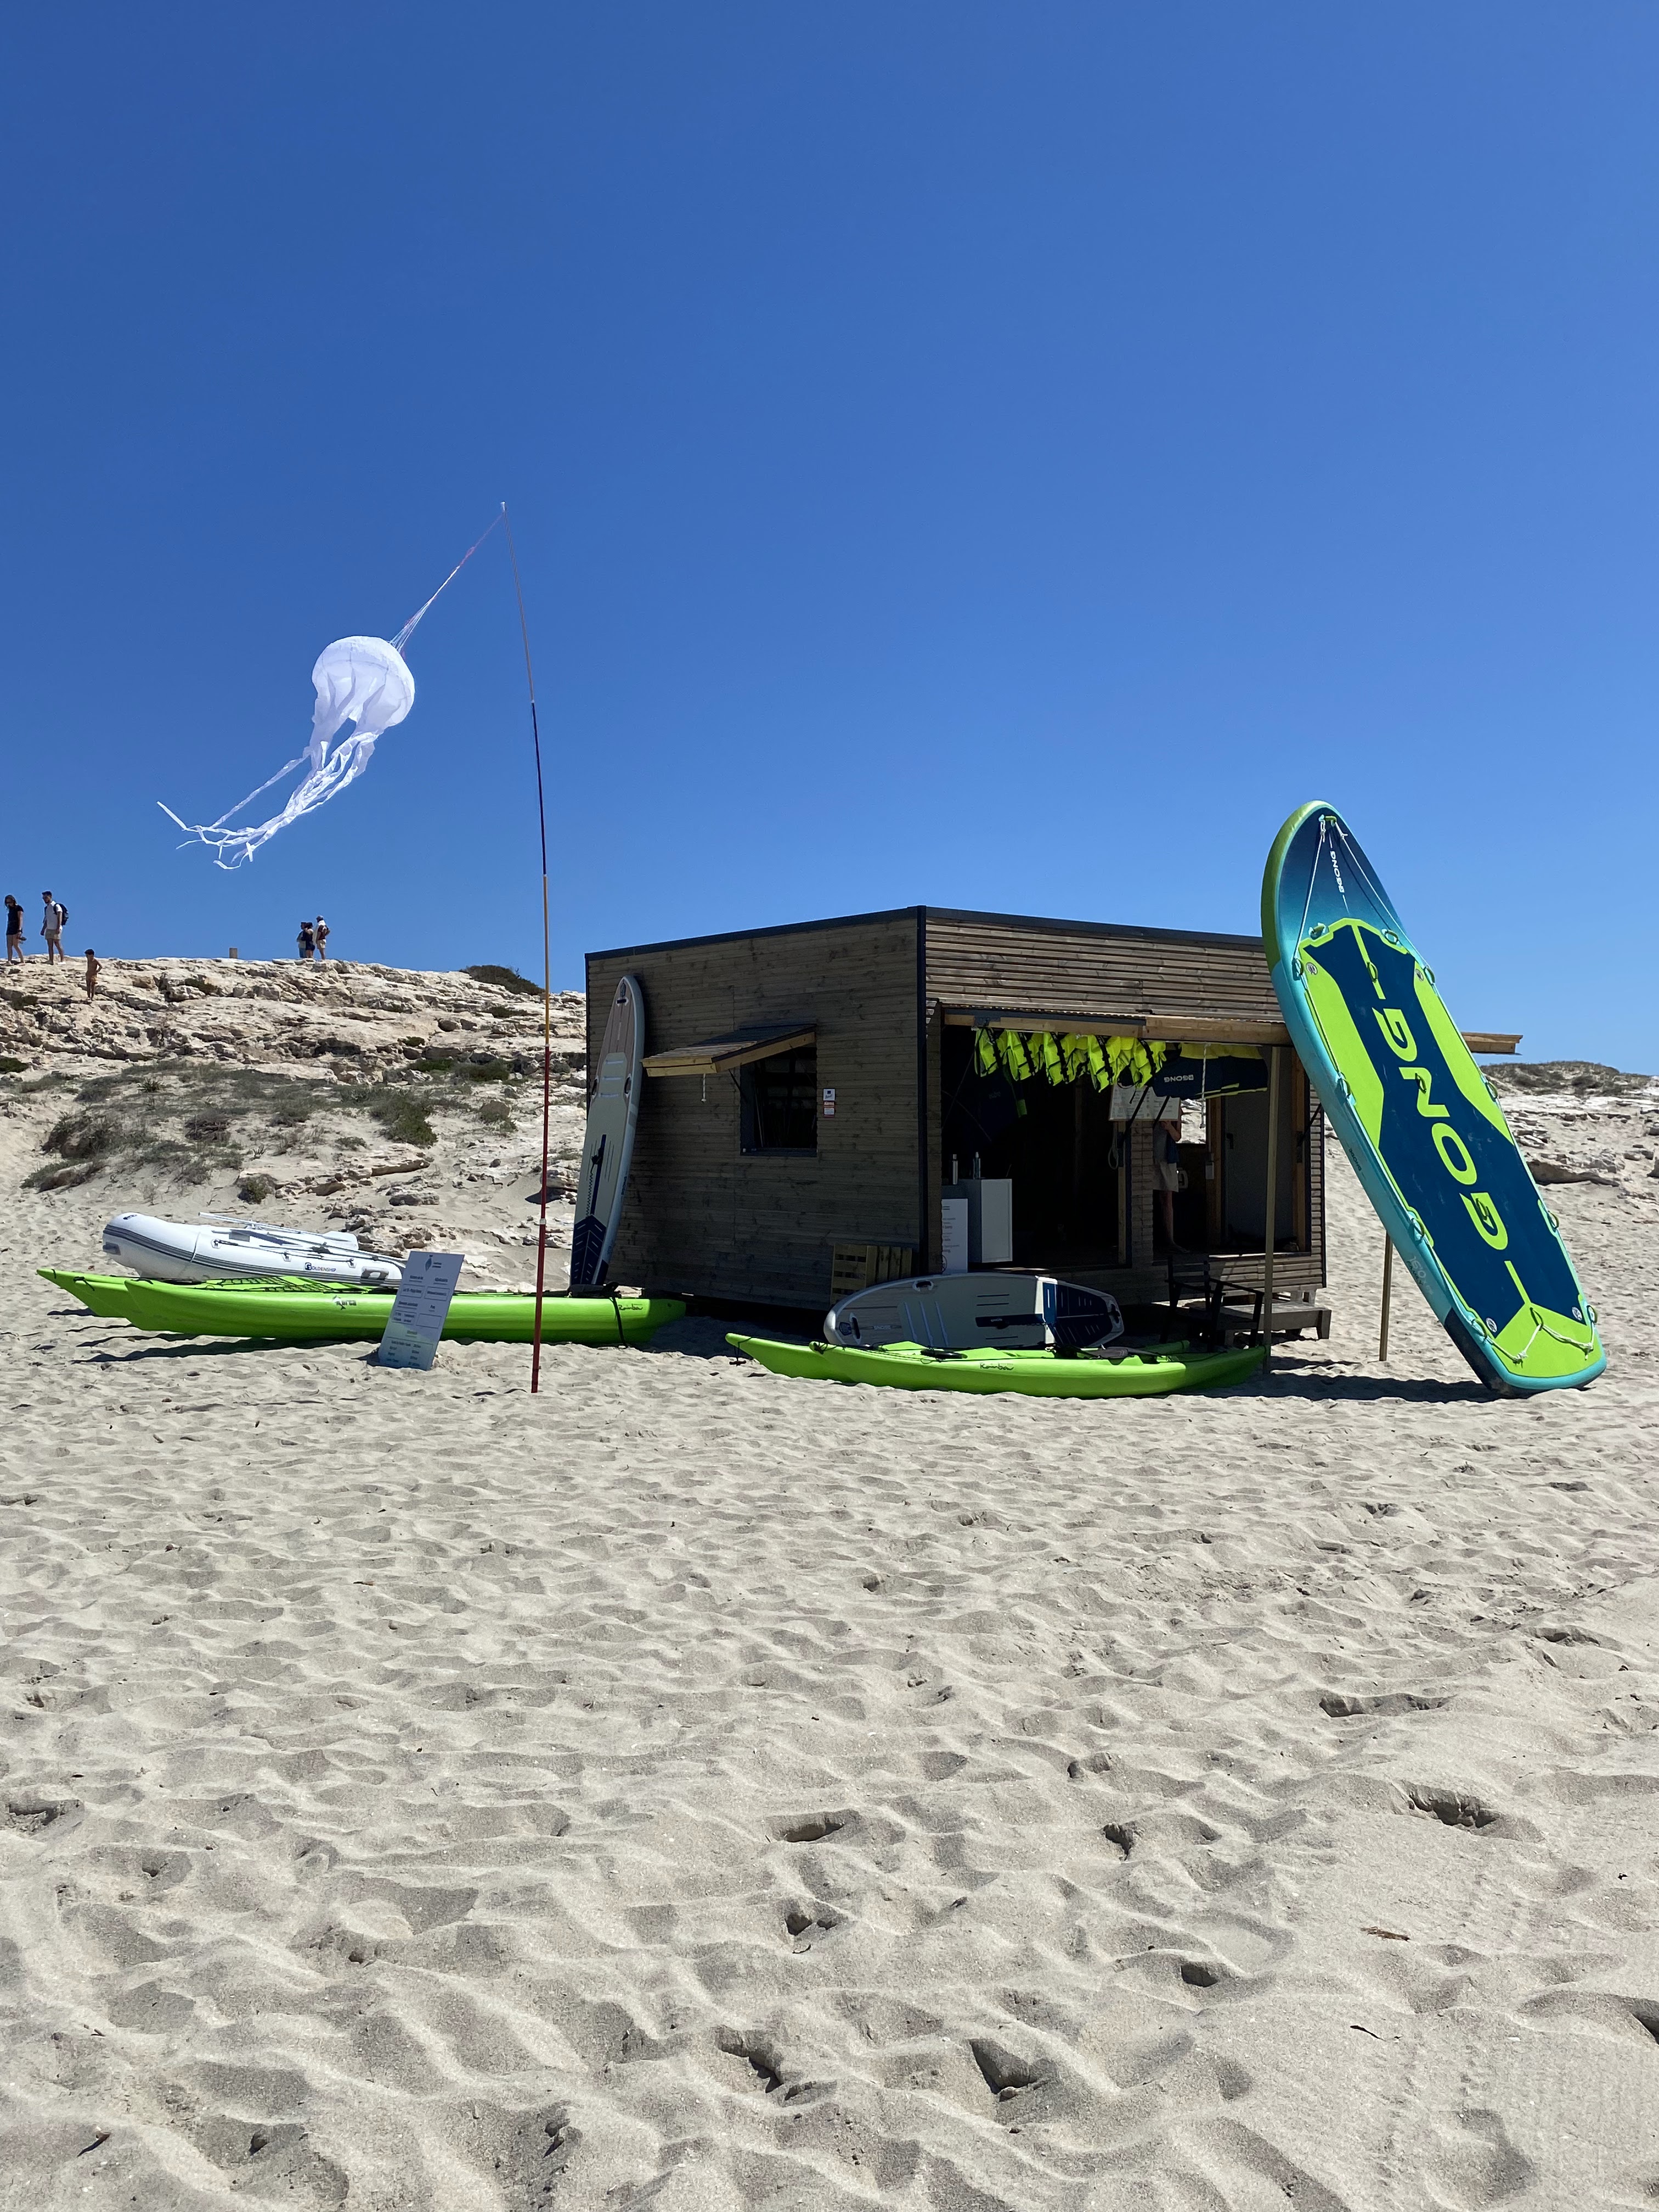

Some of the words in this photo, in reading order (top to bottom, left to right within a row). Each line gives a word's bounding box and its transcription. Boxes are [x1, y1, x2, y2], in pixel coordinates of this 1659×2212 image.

[1330, 850, 1342, 886] GONG
[1371, 1007, 1509, 1251] GONG
[304, 1262, 336, 1272] GOLDENSHIP
